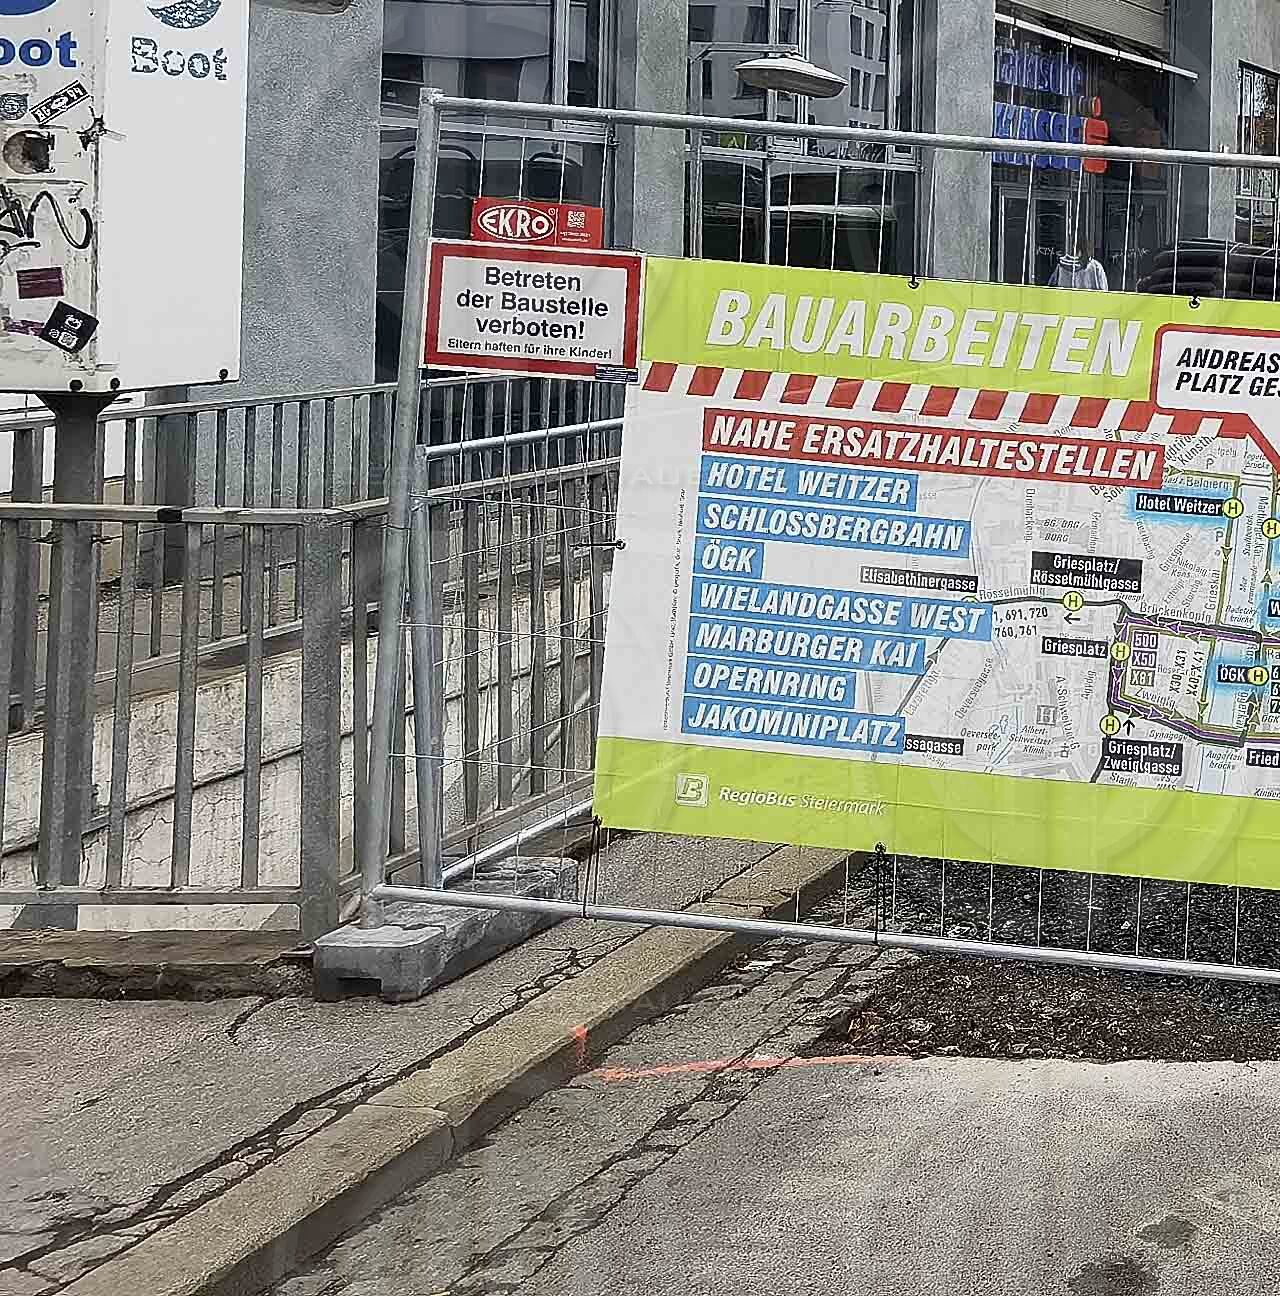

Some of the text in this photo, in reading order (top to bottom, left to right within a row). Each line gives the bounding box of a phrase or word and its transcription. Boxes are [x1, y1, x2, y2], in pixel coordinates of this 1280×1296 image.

[131, 36, 227, 80] Boot
[482, 209, 549, 238] EKRO
[485, 266, 581, 292] Betreten
[456, 289, 609, 317] der Baustelle
[475, 317, 585, 340] verboten!
[705, 290, 1143, 377] BAUARBEITEN
[448, 339, 612, 360] Eltern haften für ihre Kinder!
[1175, 371, 1243, 396] PLATZ
[710, 416, 1159, 482] NAHE ERSATZHALTESTELLEN
[706, 461, 912, 504] HOTEL WEITZER
[1138, 494, 1172, 511] Hotel
[1174, 496, 1223, 514] Weitzer
[704, 504, 964, 551] SCHLOSSBERGBAHN
[701, 540, 757, 573] ÖGK
[1053, 556, 1120, 574] Griesplatz/
[862, 567, 977, 592] Elisabethinergasse
[1033, 569, 1139, 593] Rösselmühlgasse
[699, 583, 986, 635] WIELANDGASSE WEST
[993, 608, 1048, 622] 1,691,720
[695, 623, 918, 668] MARBURGER KAI
[1044, 640, 1106, 658] Griesplatz
[692, 664, 848, 702] OPERNRING
[1220, 665, 1245, 682] ÖGK
[688, 705, 900, 748] JAKOMINIPLATZ
[1108, 742, 1176, 759] Griesplatz/
[1104, 756, 1181, 775] Zweiglgasse
[720, 787, 887, 815] RegioBus Steiermark
